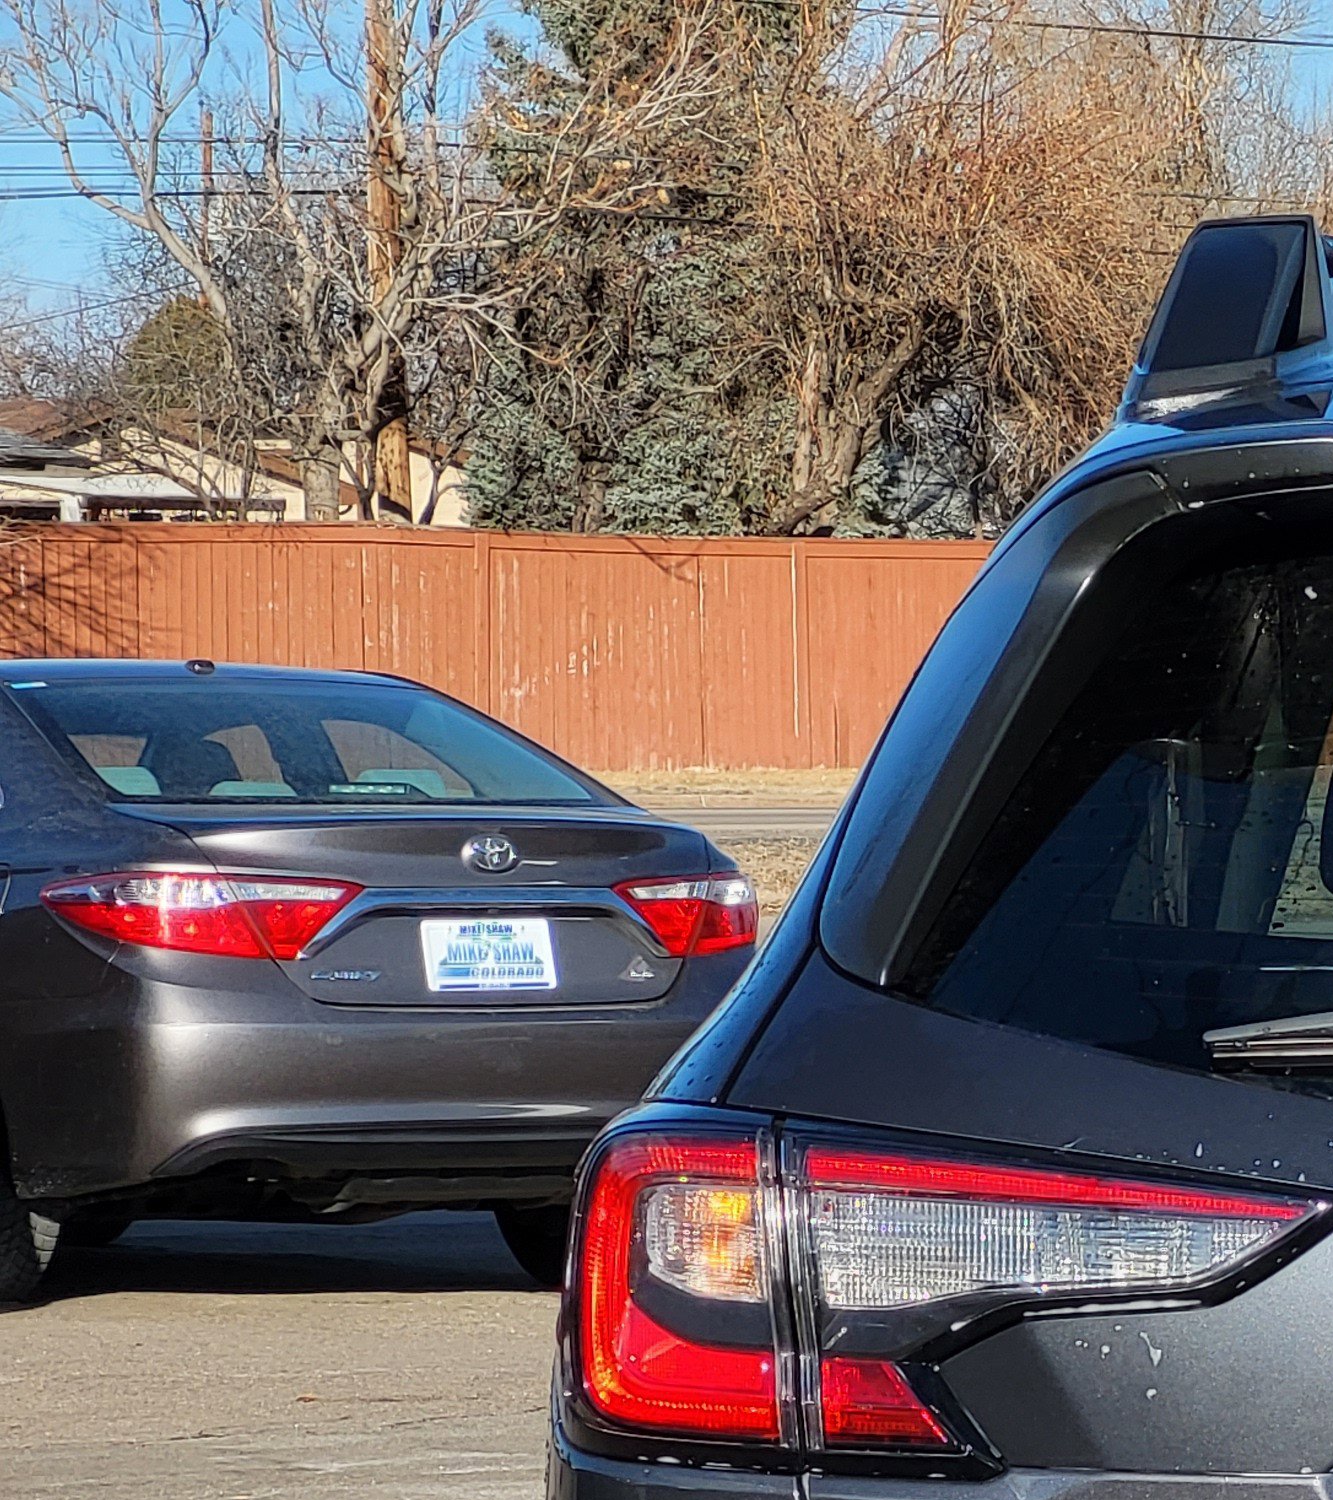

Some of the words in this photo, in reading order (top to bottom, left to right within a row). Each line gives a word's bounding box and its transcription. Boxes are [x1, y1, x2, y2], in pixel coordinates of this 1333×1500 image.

[446, 942, 487, 961] MIKE
[492, 942, 534, 961] SHAW
[471, 967, 545, 977] COLORADO
